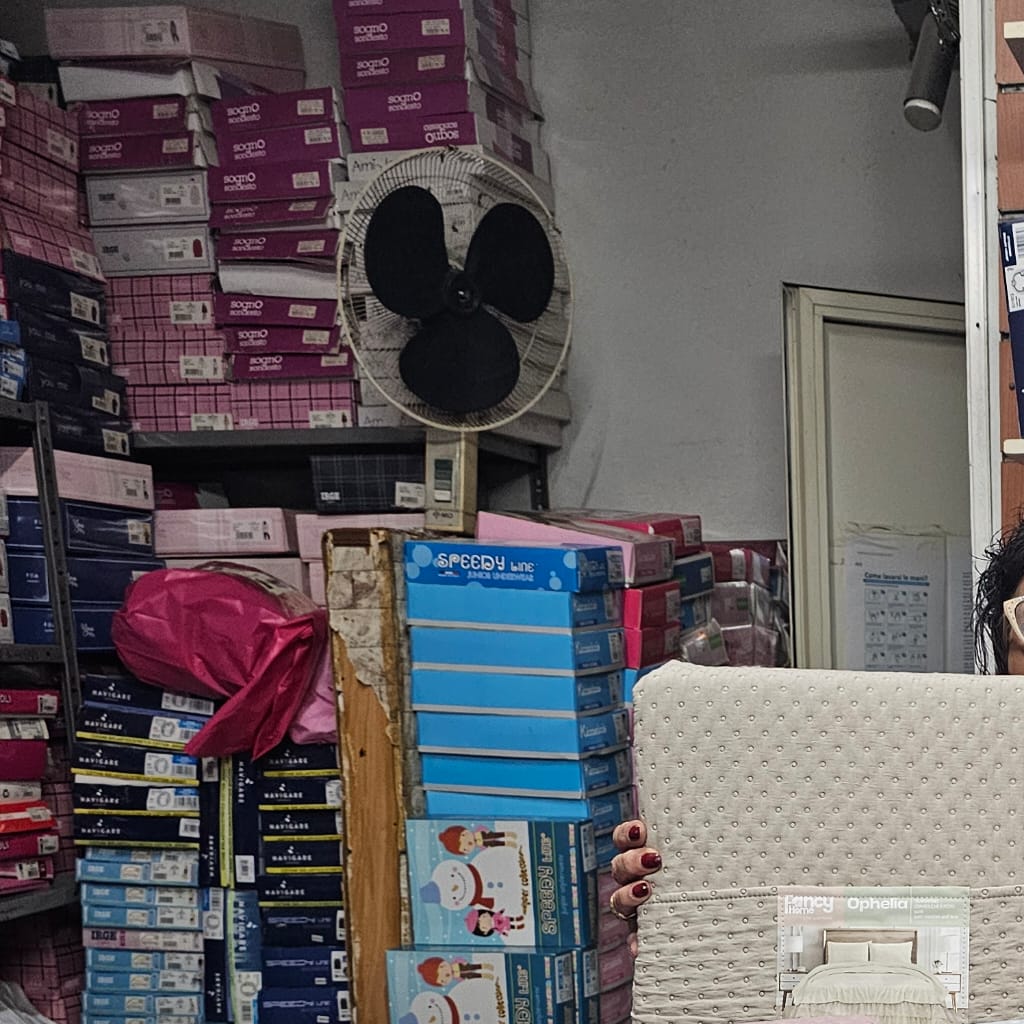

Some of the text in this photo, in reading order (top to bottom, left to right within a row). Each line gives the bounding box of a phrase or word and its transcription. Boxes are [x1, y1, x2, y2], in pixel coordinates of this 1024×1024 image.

[437, 552, 505, 570] SPEEDY
[537, 865, 558, 936] SPEEDY
[785, 894, 834, 914] Fancy
[847, 897, 908, 912] Ophelia
[91, 930, 117, 940] IRGE
